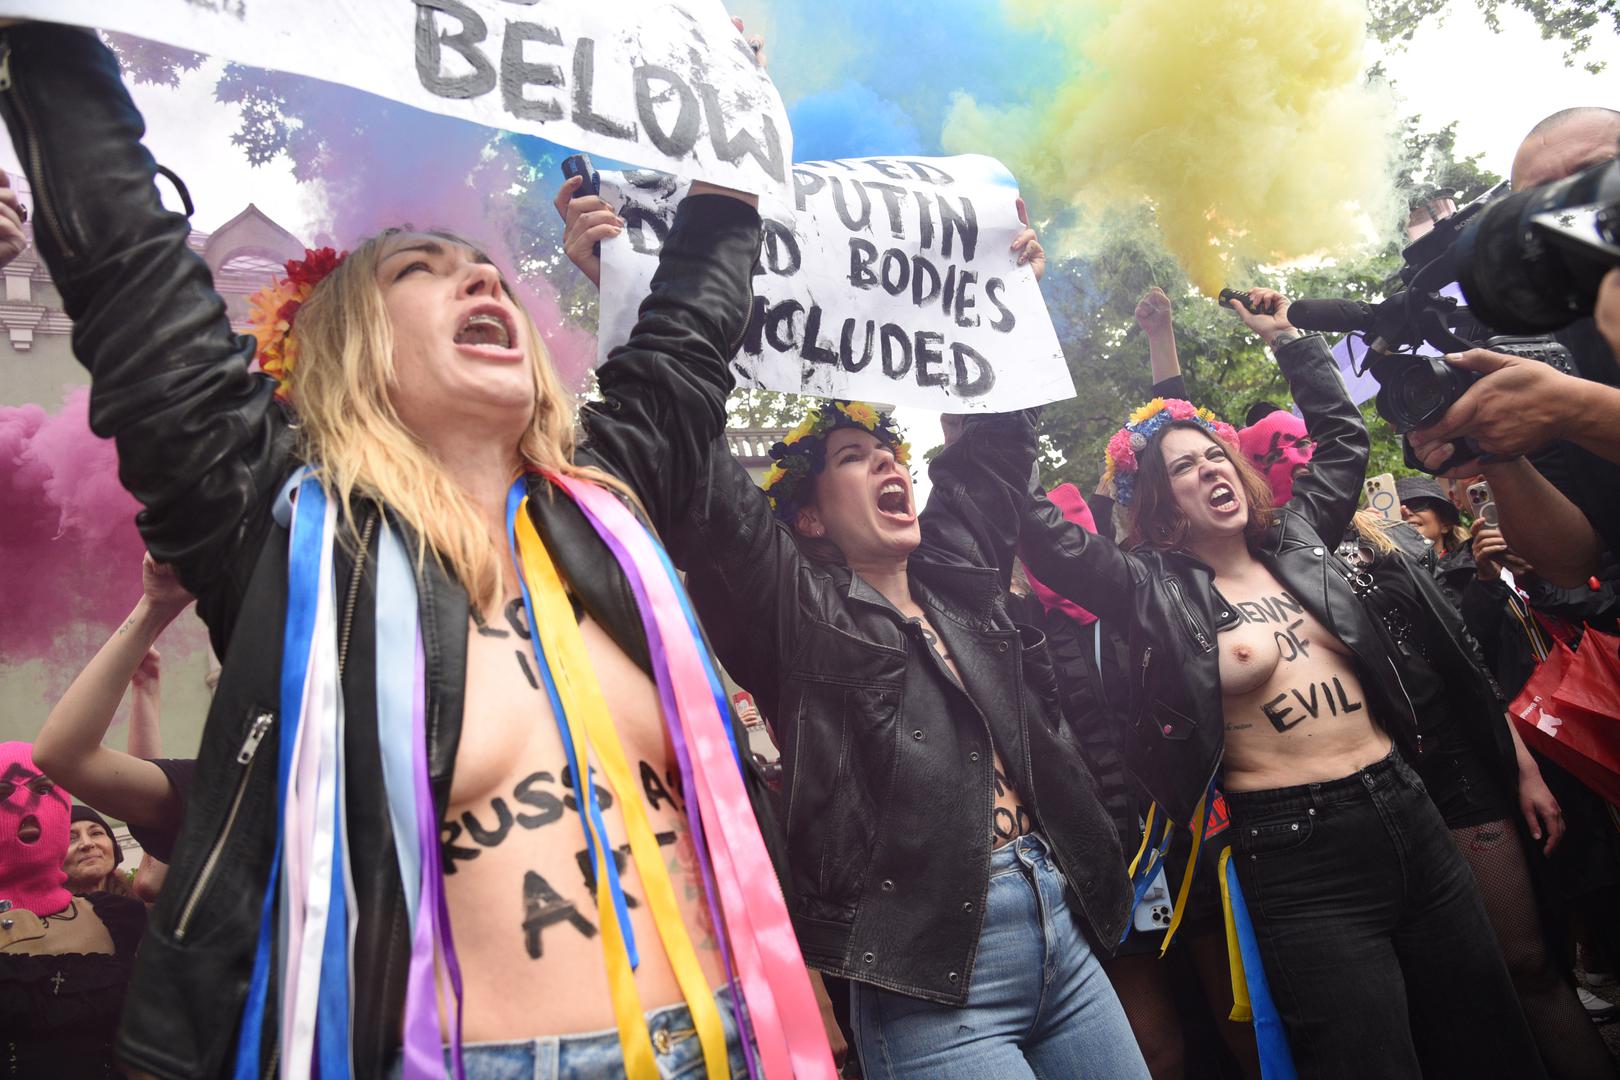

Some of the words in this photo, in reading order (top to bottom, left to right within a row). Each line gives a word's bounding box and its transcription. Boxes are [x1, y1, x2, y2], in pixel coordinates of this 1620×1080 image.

[415, 0, 786, 184] BELOW
[792, 169, 978, 263] PUTIN
[619, 205, 802, 277] DD
[849, 237, 1016, 333] BODIES
[1274, 619, 1310, 662] OF
[1261, 677, 1362, 733] EVIL
